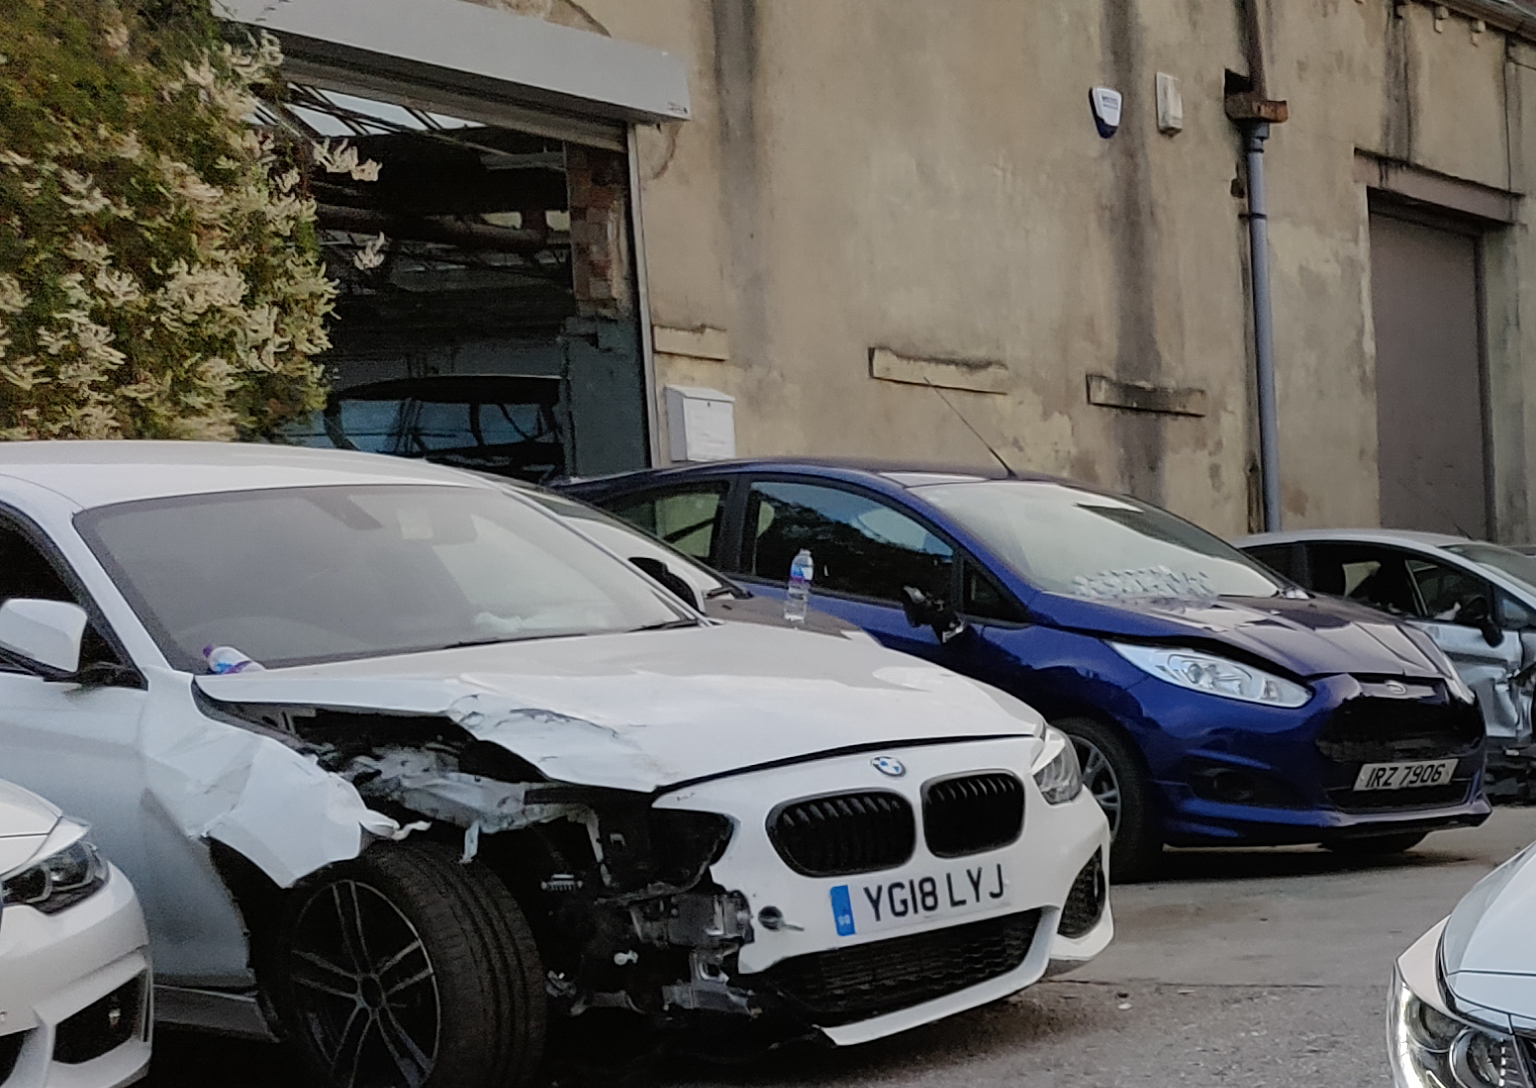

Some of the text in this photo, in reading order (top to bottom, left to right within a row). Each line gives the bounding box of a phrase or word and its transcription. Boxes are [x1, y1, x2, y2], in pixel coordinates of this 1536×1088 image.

[1365, 762, 1446, 789] IRZ 7906
[863, 863, 1004, 922] YG18 LYJ
